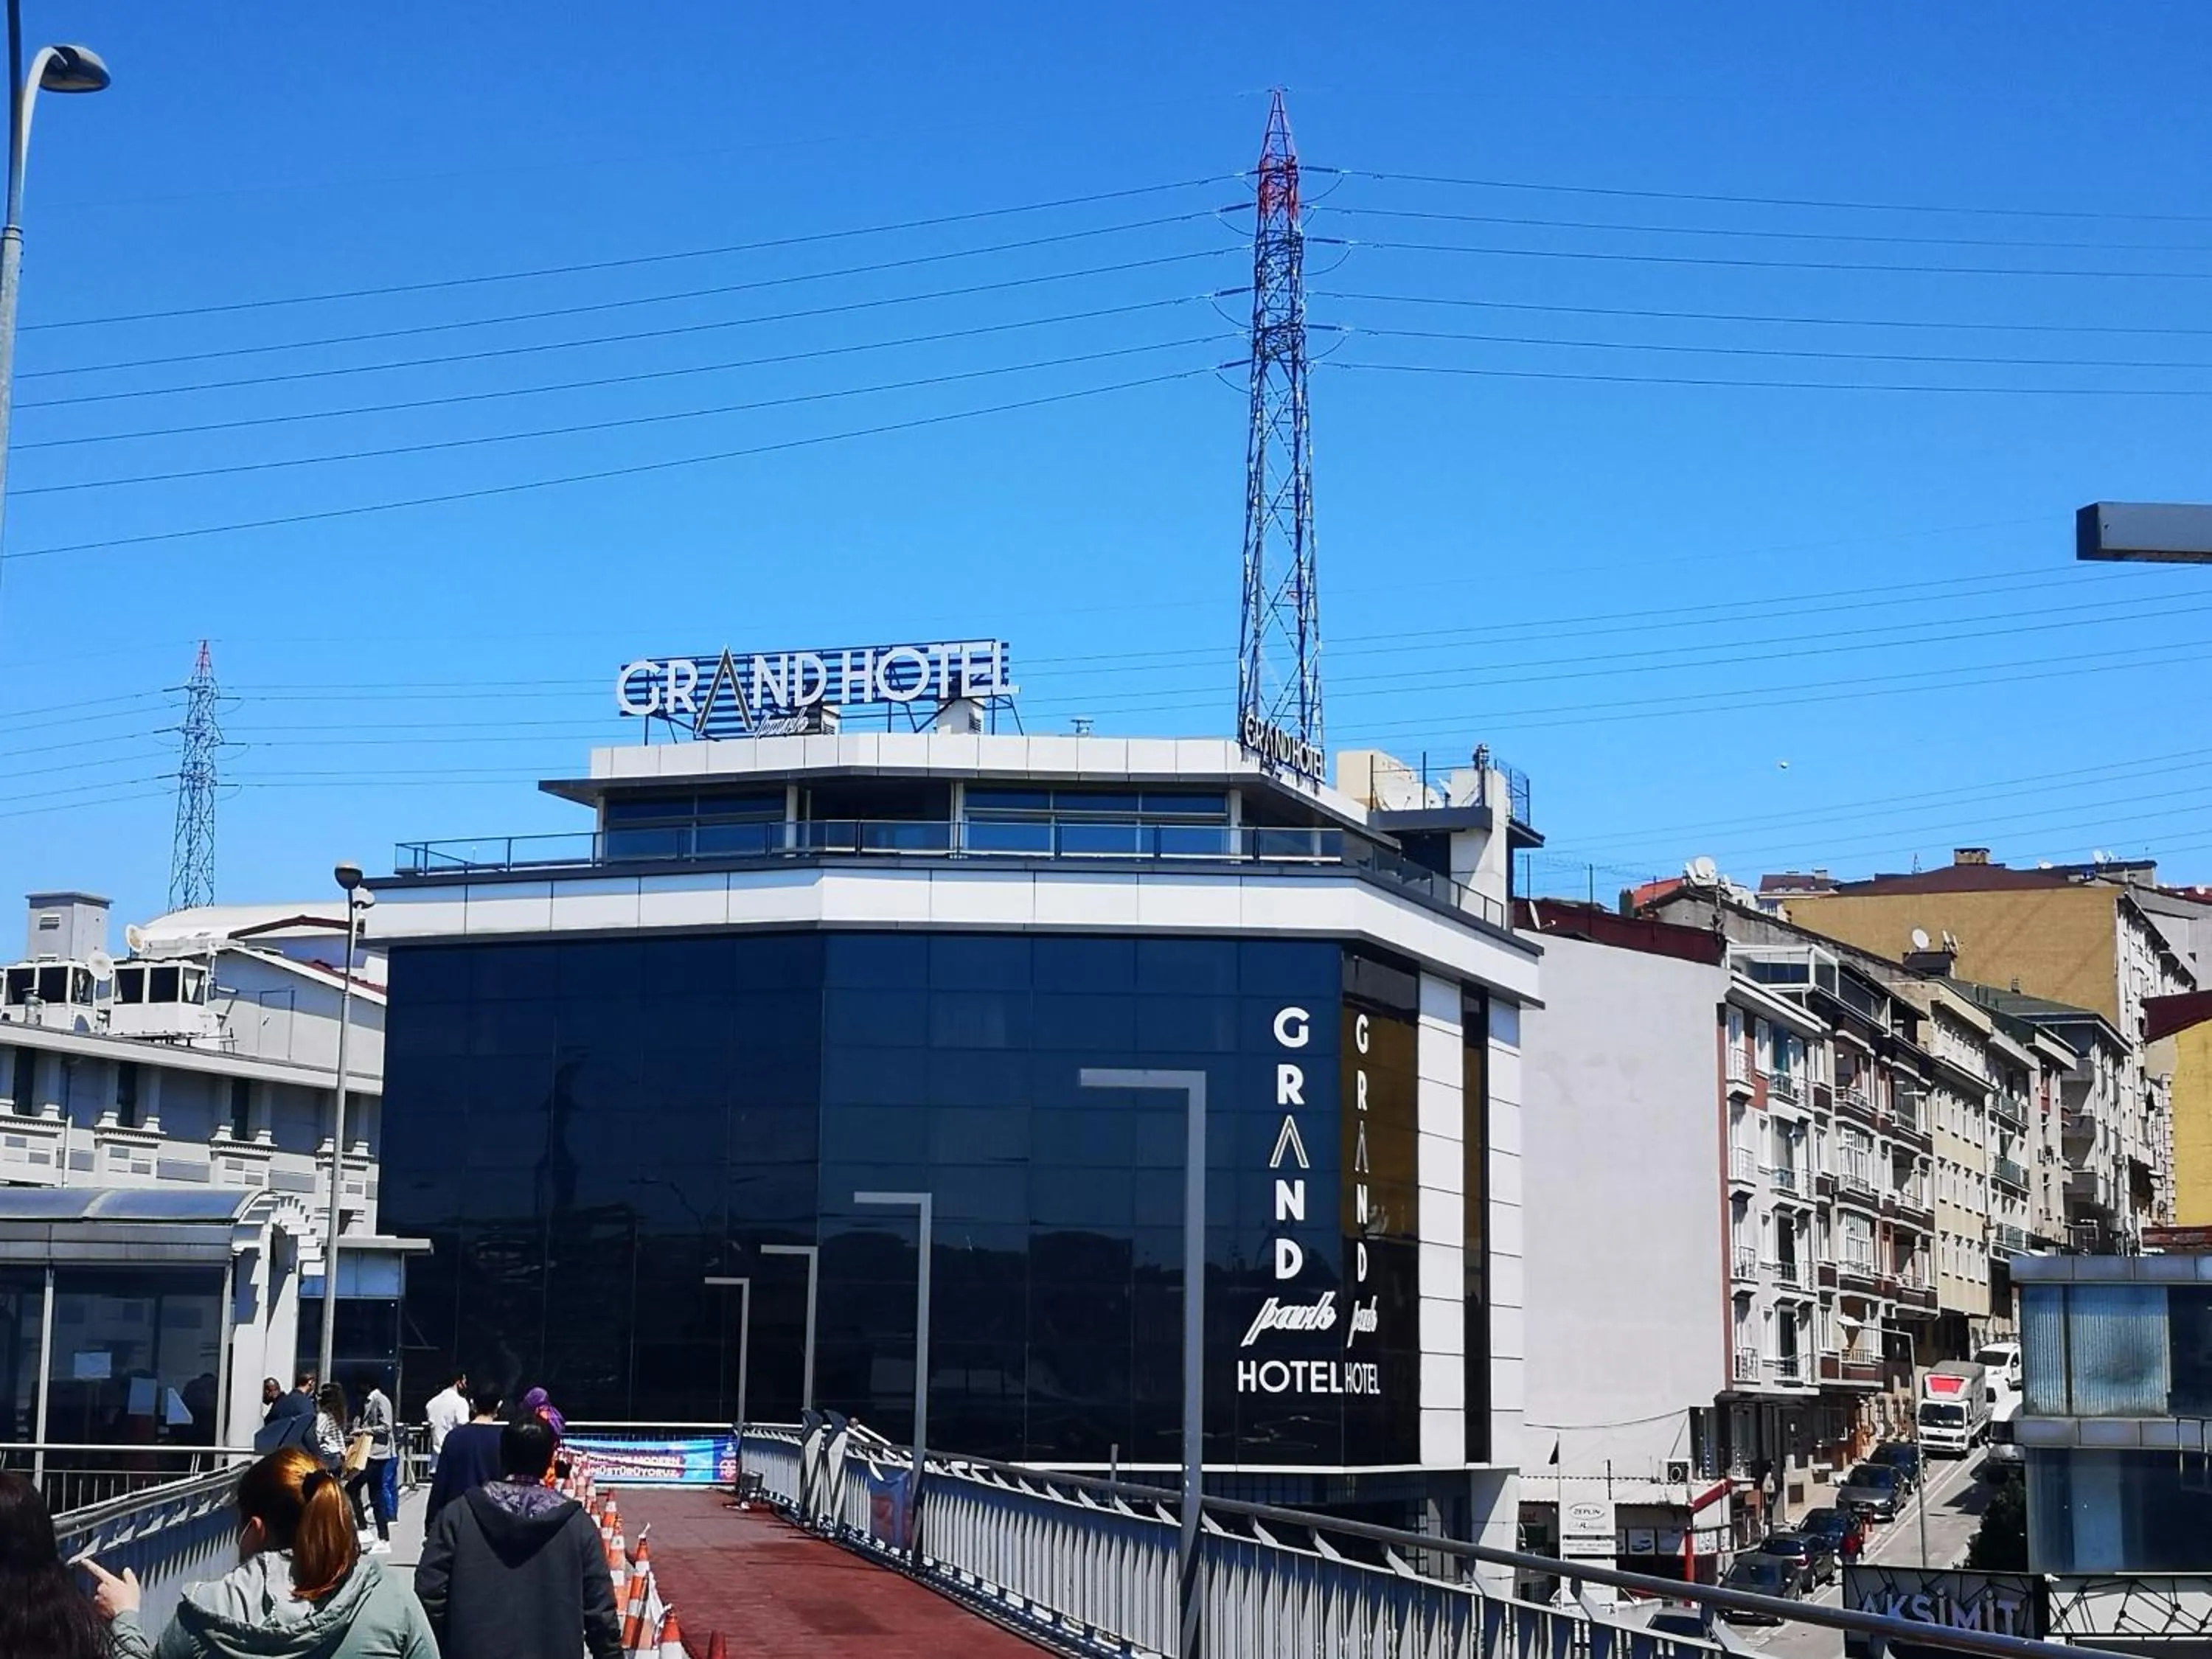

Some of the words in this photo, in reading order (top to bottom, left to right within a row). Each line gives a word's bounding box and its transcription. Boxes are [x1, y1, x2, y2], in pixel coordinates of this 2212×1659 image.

[616, 644, 827, 736] GRAND
[843, 640, 1020, 703] HOTEL
[1244, 714, 1291, 765] GRAND
[1293, 737, 1326, 782] HOTEL
[1269, 1006, 1310, 1279] GRAND
[1355, 1014, 1370, 1282] GRAND
[1240, 1291, 1337, 1347] park
[1238, 1360, 1344, 1393] HOTEL
[1344, 1363, 1381, 1394] HOTEL
